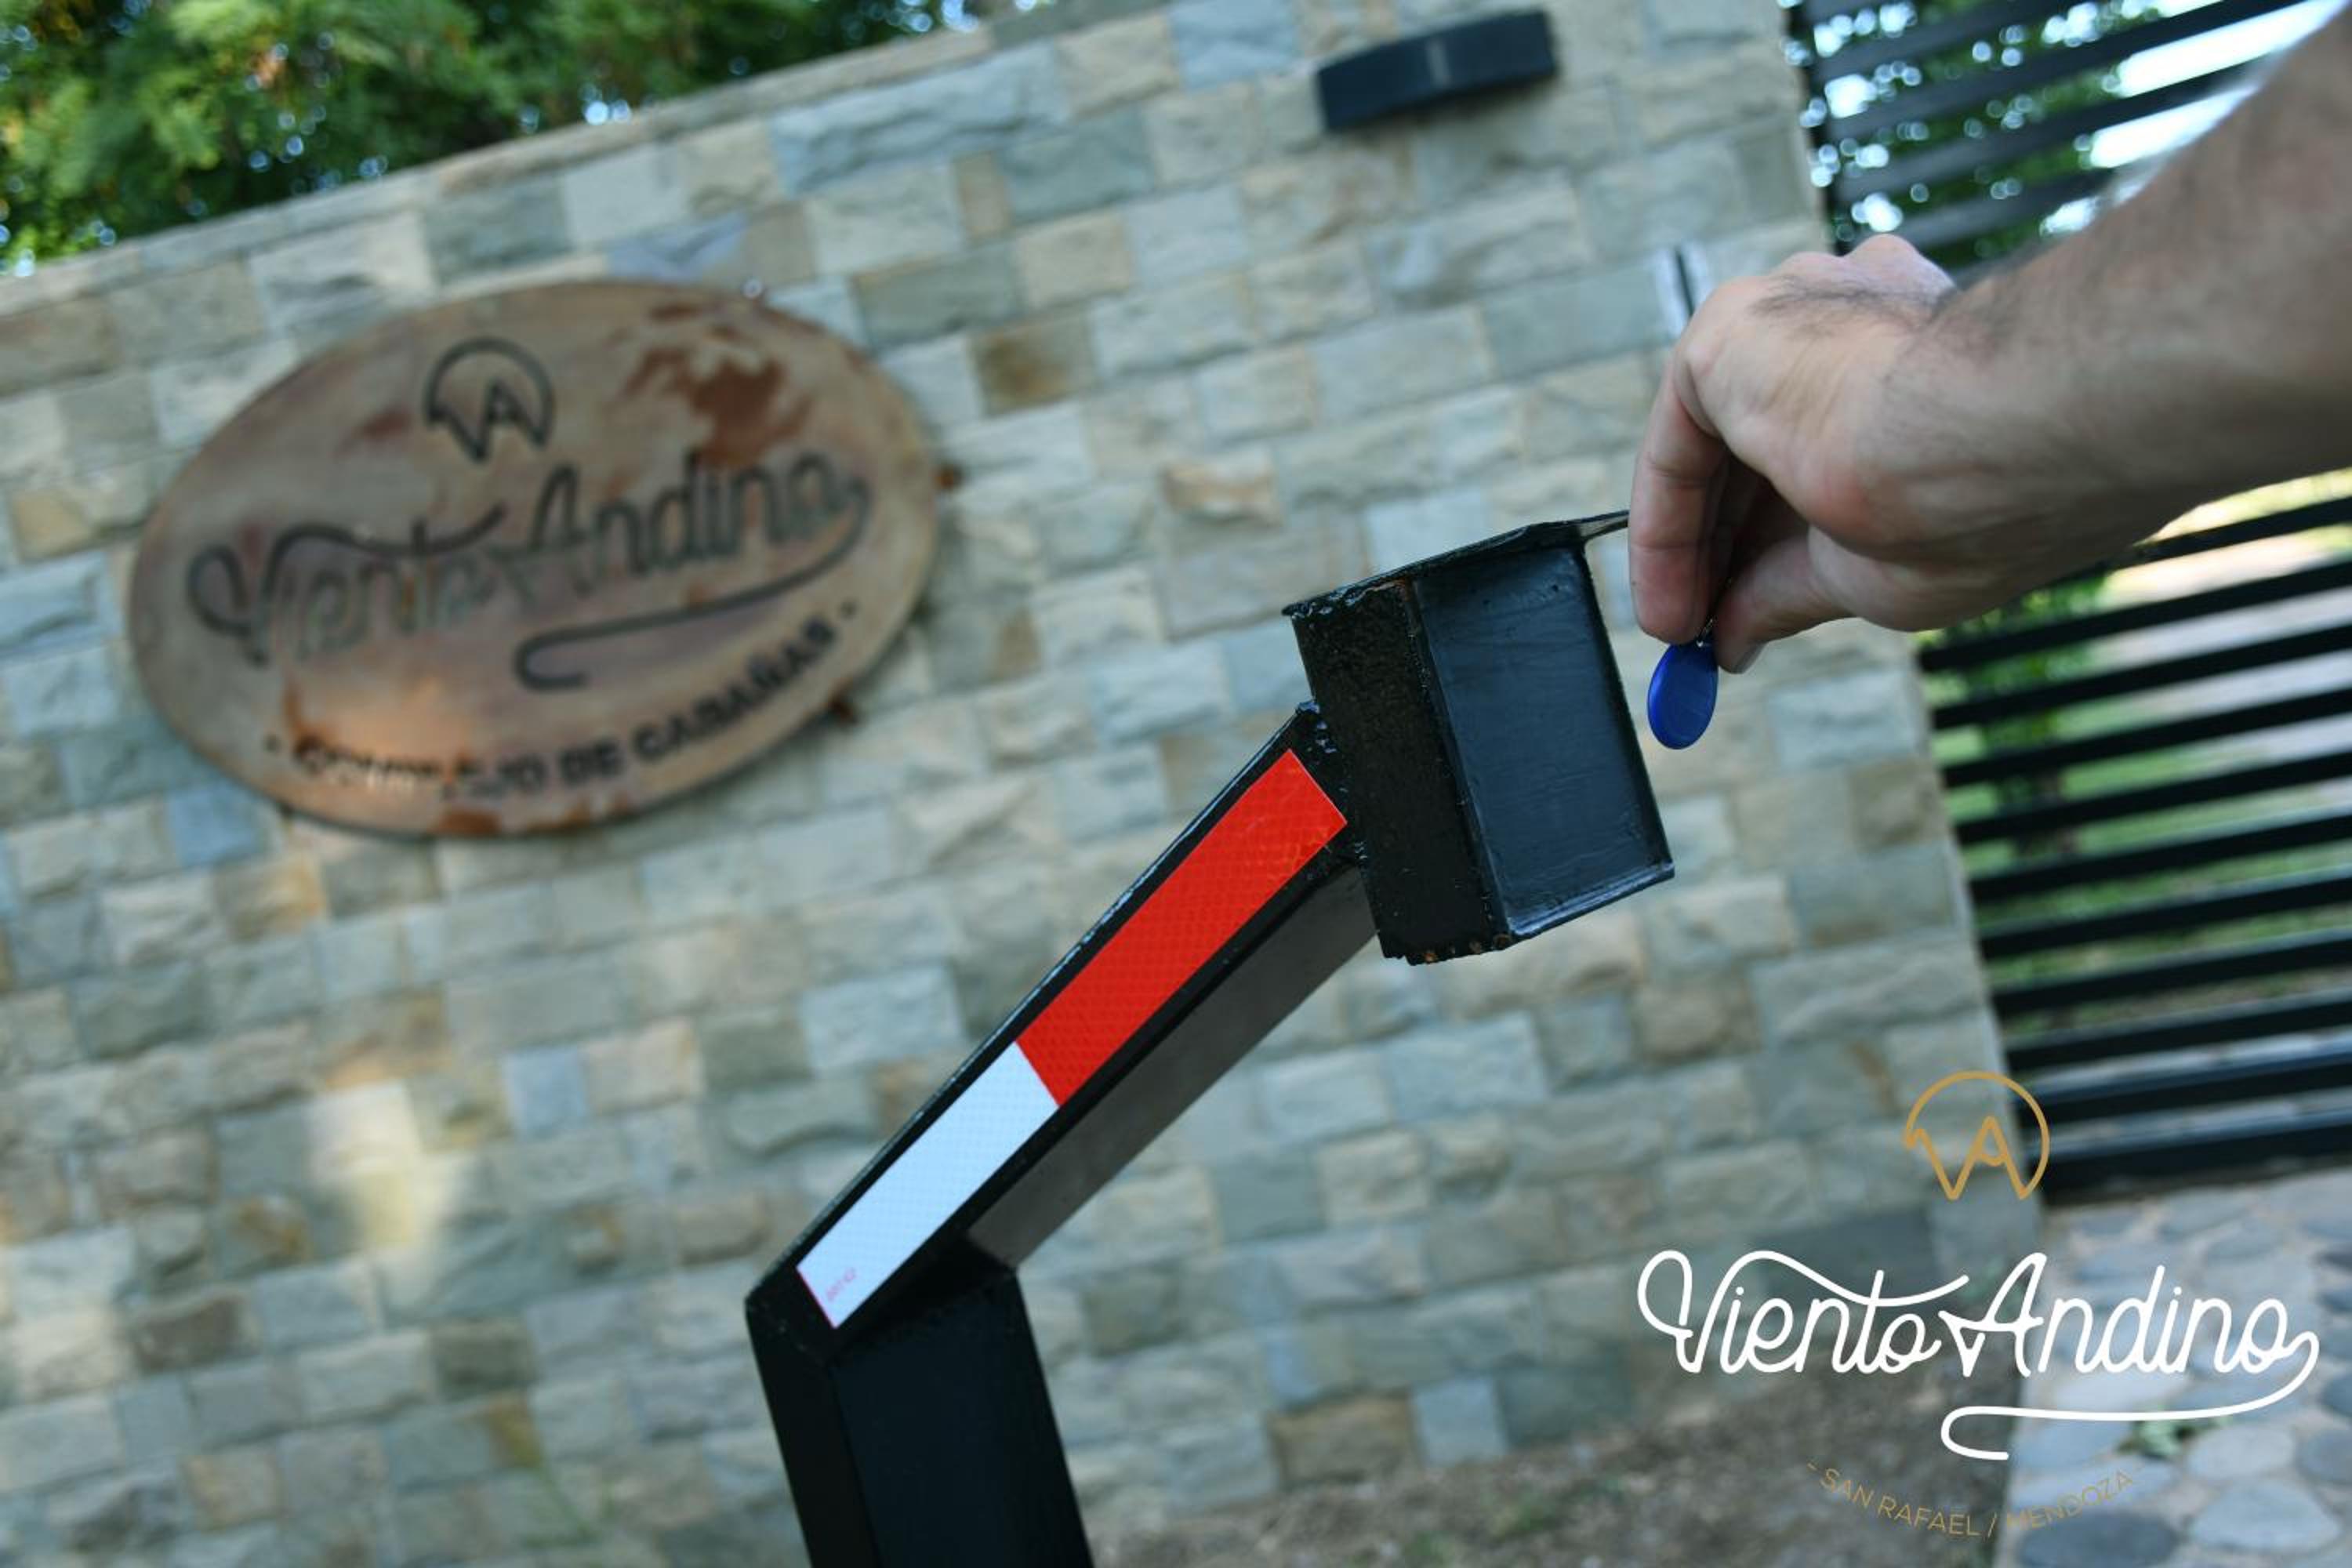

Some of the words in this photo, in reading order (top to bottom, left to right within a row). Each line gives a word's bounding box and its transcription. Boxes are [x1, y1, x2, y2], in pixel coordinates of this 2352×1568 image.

[188, 502, 508, 666] Viento
[483, 451, 874, 691] Andino
[560, 737, 624, 782] DE
